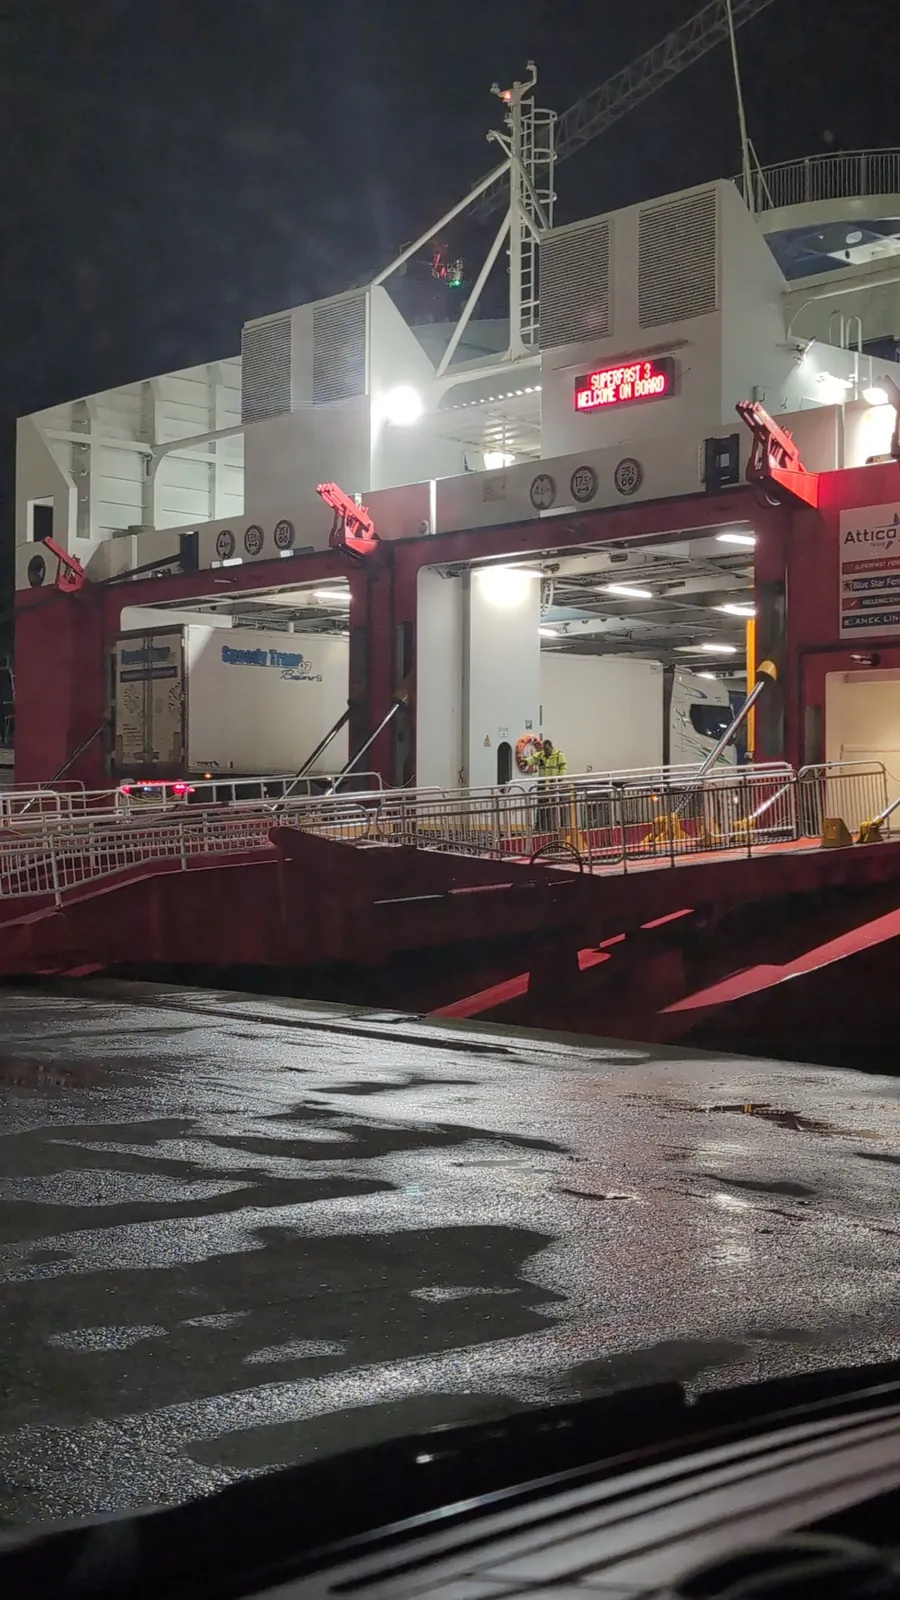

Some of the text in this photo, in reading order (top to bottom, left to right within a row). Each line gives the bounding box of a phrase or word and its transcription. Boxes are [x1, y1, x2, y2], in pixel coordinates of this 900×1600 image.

[591, 362, 651, 390] SUPERFAST 3
[577, 375, 665, 409] WELCOME ON BOARD
[843, 528, 896, 545] Attica
[870, 579, 885, 588] Star
[855, 614, 900, 625] ANEK LIN
